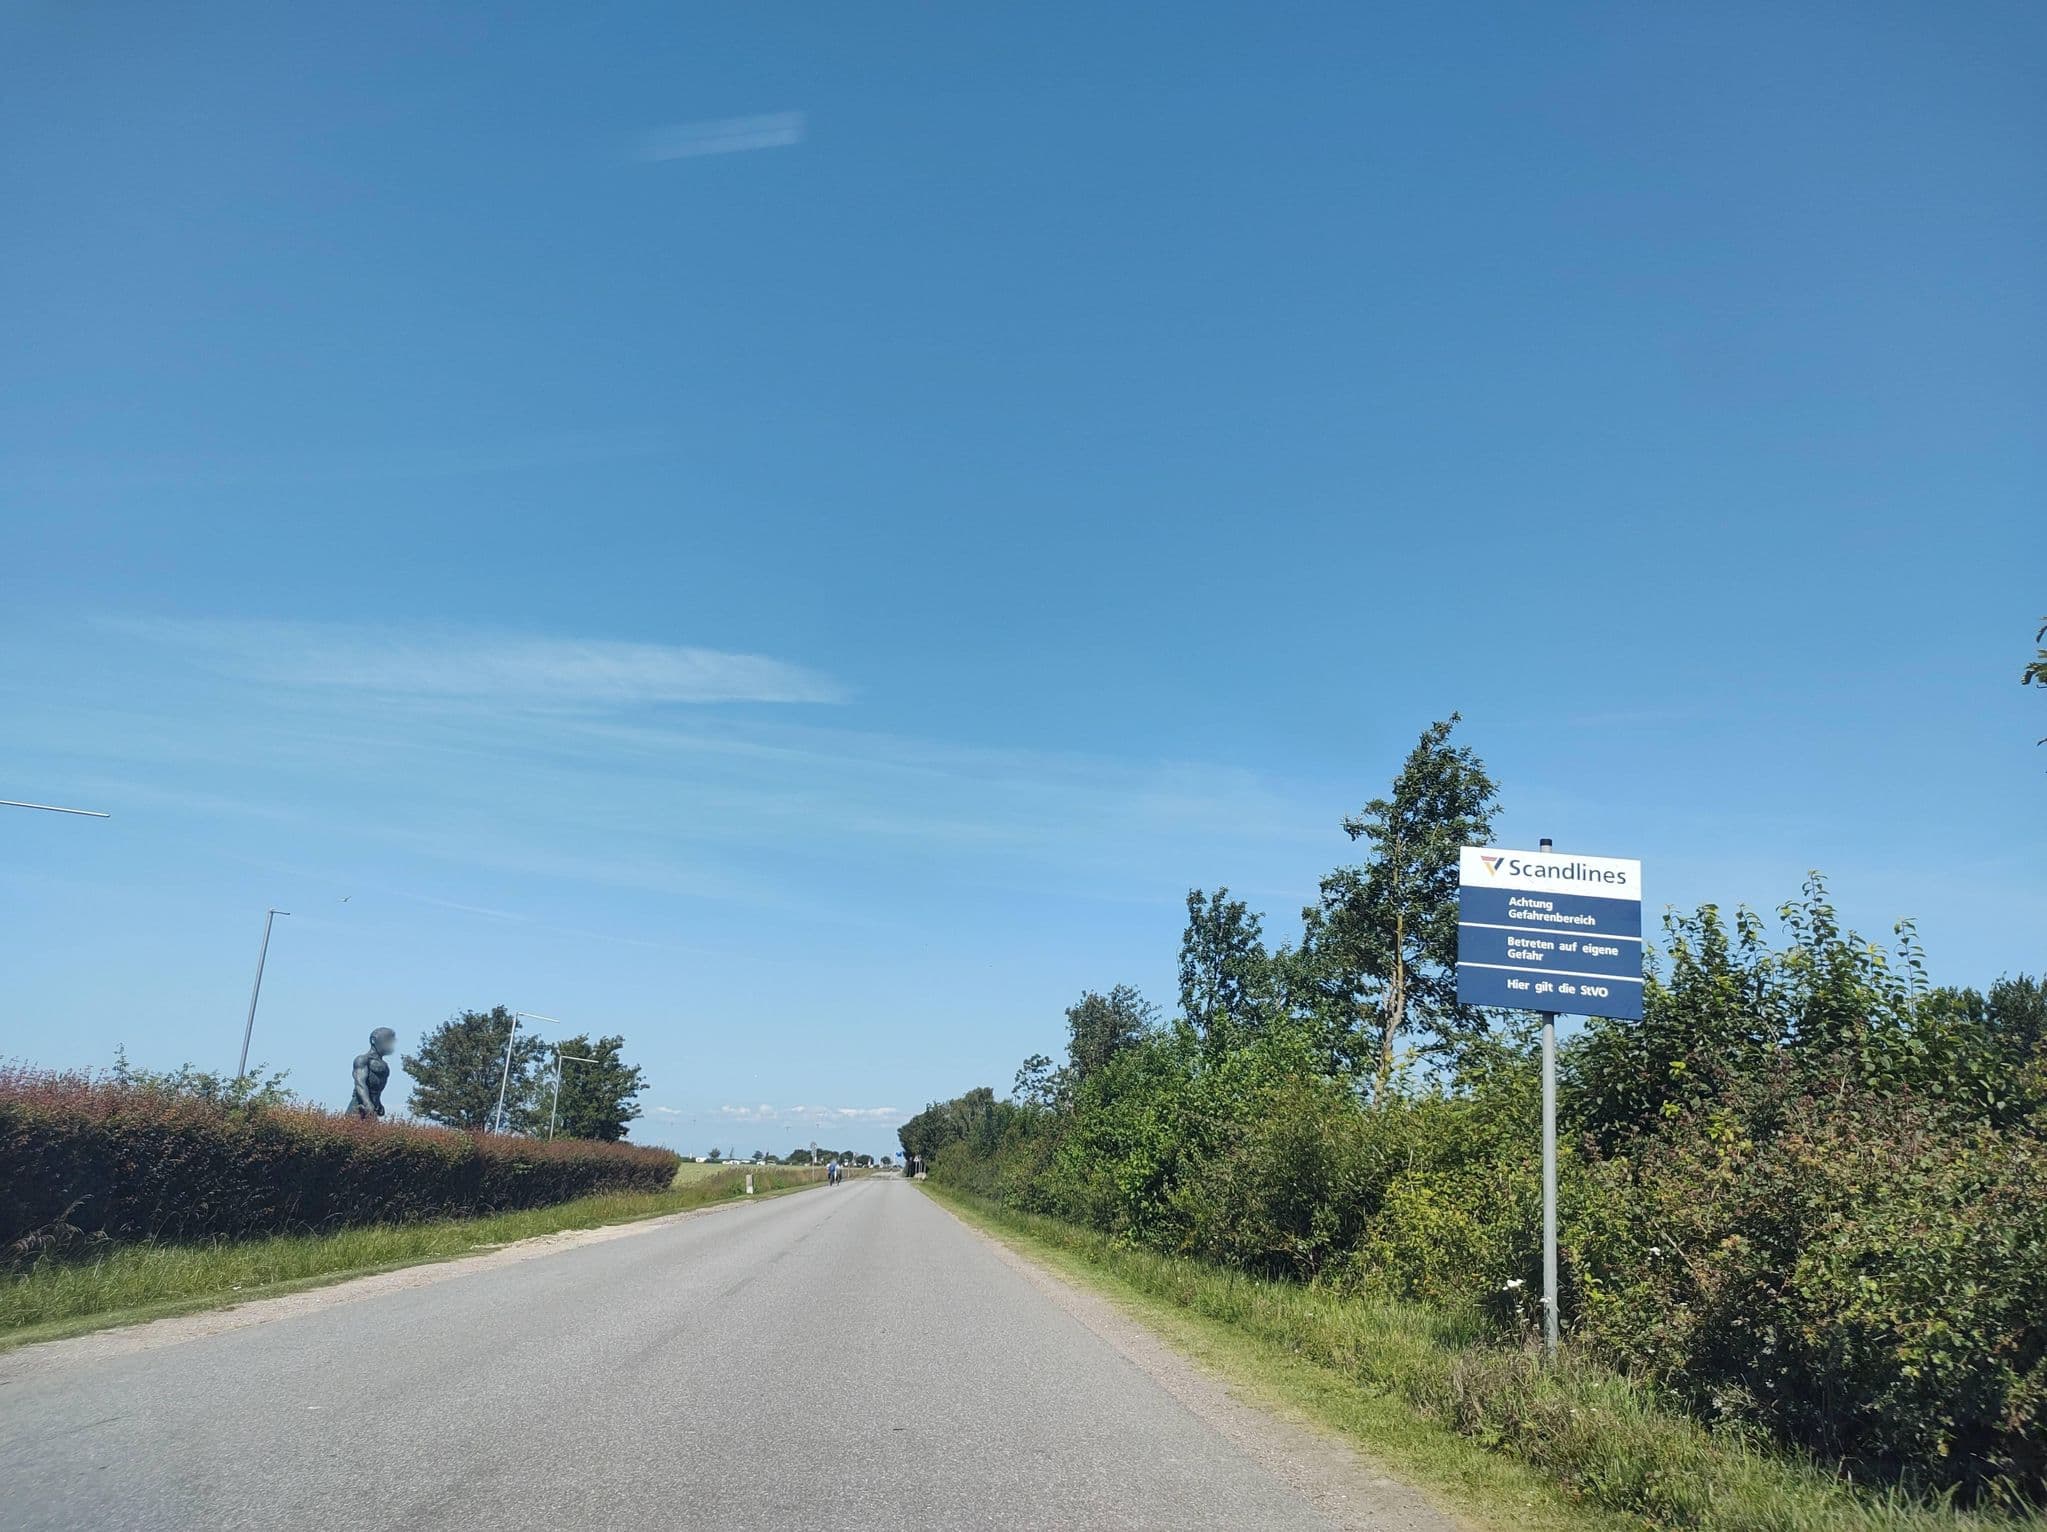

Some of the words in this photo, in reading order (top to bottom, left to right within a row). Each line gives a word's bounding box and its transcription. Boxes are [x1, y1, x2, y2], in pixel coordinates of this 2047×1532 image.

[1509, 860, 1626, 884] Scandlines
[1509, 897, 1553, 911] Achtung
[1508, 910, 1596, 925] Gefahrenbereich
[1508, 937, 1554, 950] Betreten
[1559, 942, 1577, 951] auf
[1583, 943, 1619, 955] eigene
[1507, 949, 1544, 961] Gefahr
[1507, 979, 1529, 990] Hier
[1535, 981, 1553, 993] gilt
[1559, 982, 1576, 994] die
[1581, 986, 1608, 997] StVO
